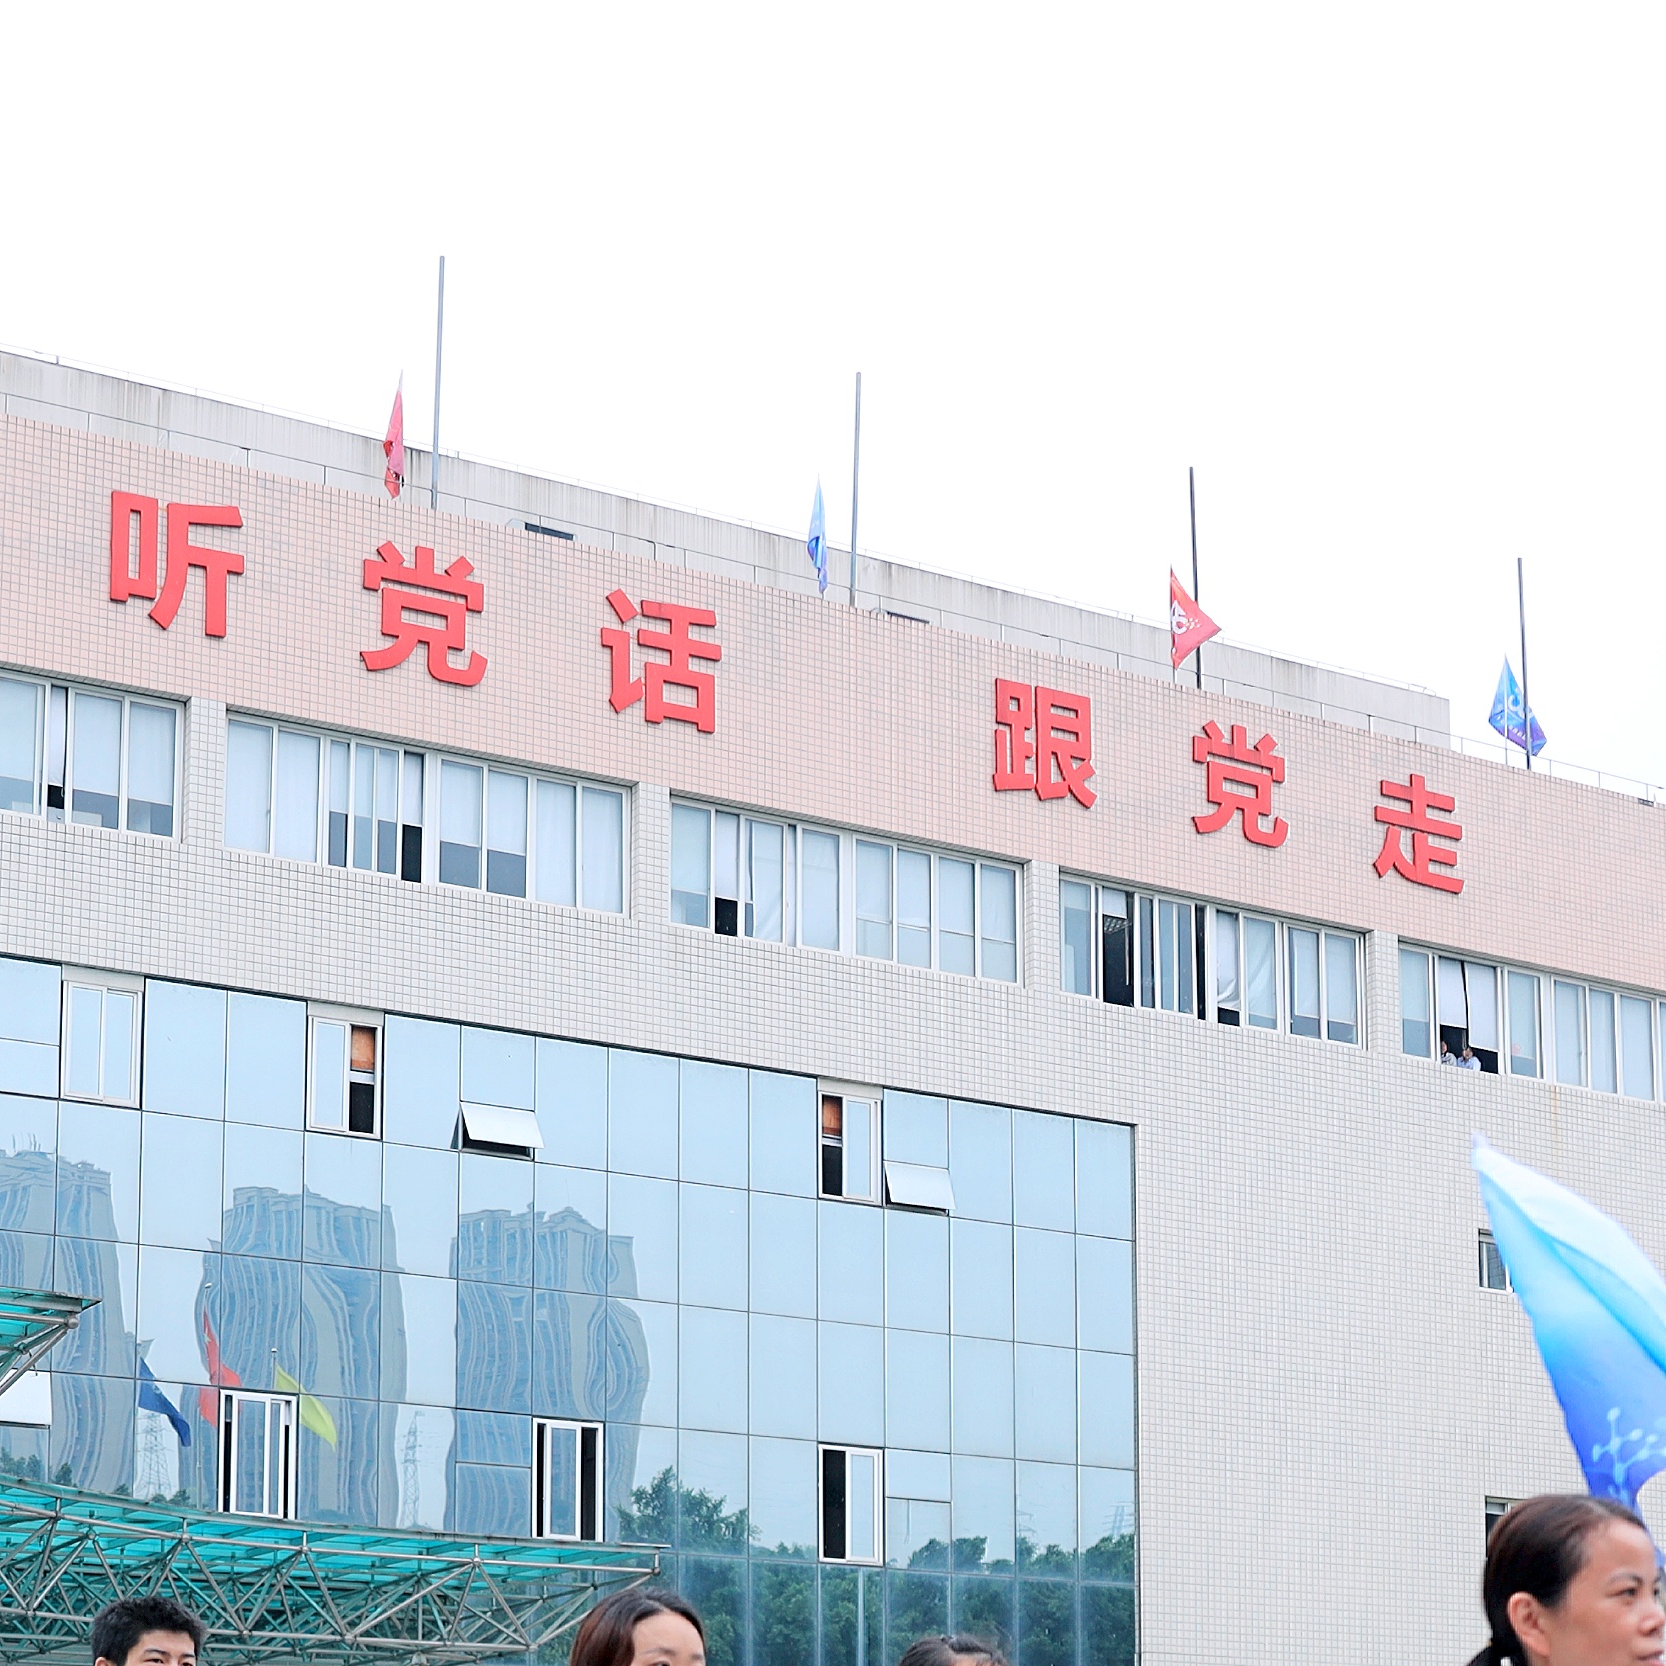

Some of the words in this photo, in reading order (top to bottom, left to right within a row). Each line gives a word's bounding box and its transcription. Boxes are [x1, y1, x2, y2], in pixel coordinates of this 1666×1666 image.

[109, 490, 722, 734] 听党话
[991, 677, 1466, 895] 跟党走
